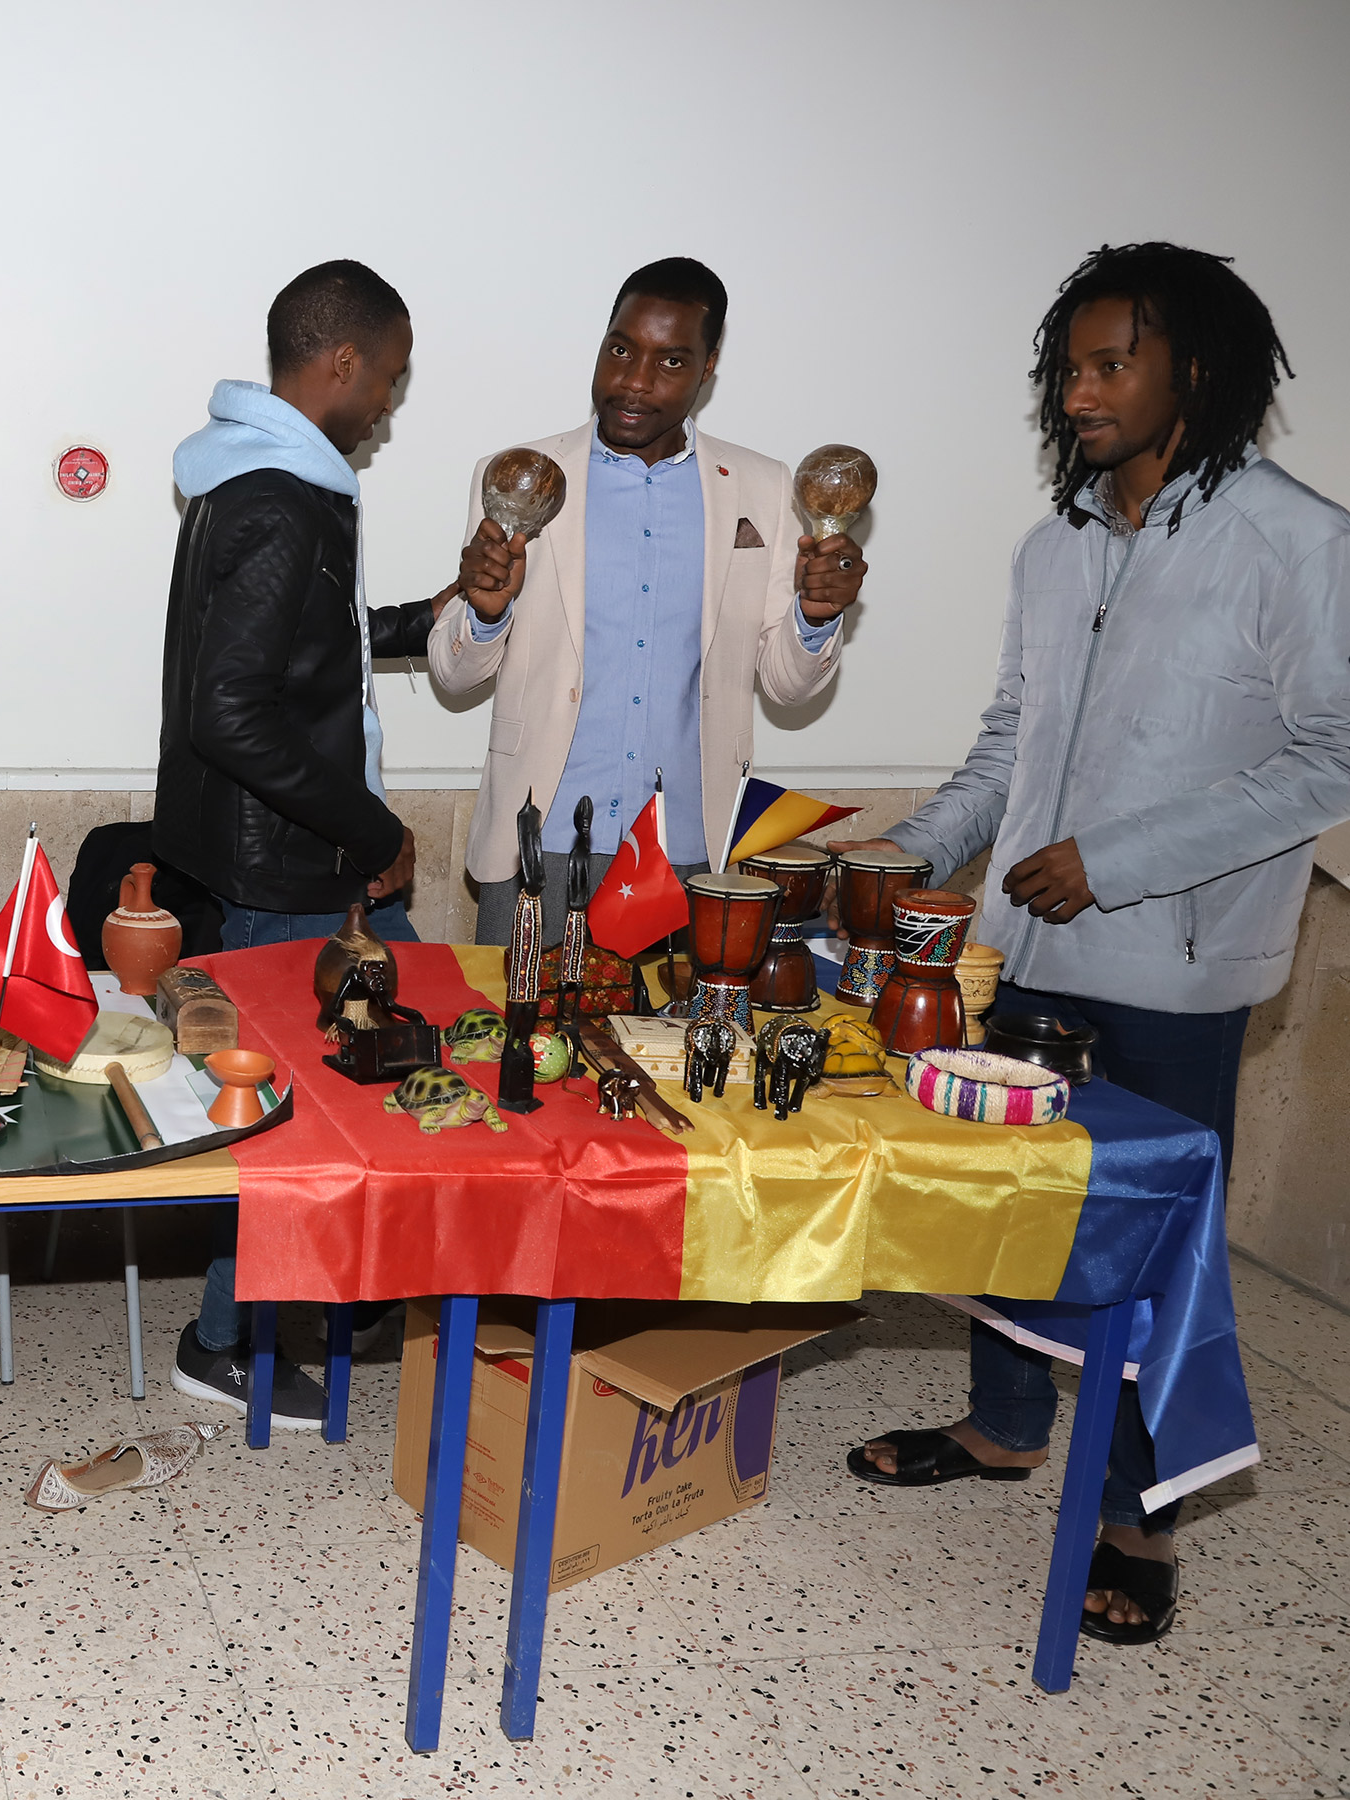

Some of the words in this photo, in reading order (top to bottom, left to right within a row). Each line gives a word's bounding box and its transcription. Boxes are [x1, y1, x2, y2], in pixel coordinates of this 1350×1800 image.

[632, 1510, 653, 1526] Torta
[683, 1488, 705, 1504] Fruta
[647, 1489, 673, 1507] Fruity
[676, 1481, 693, 1495] Cake
